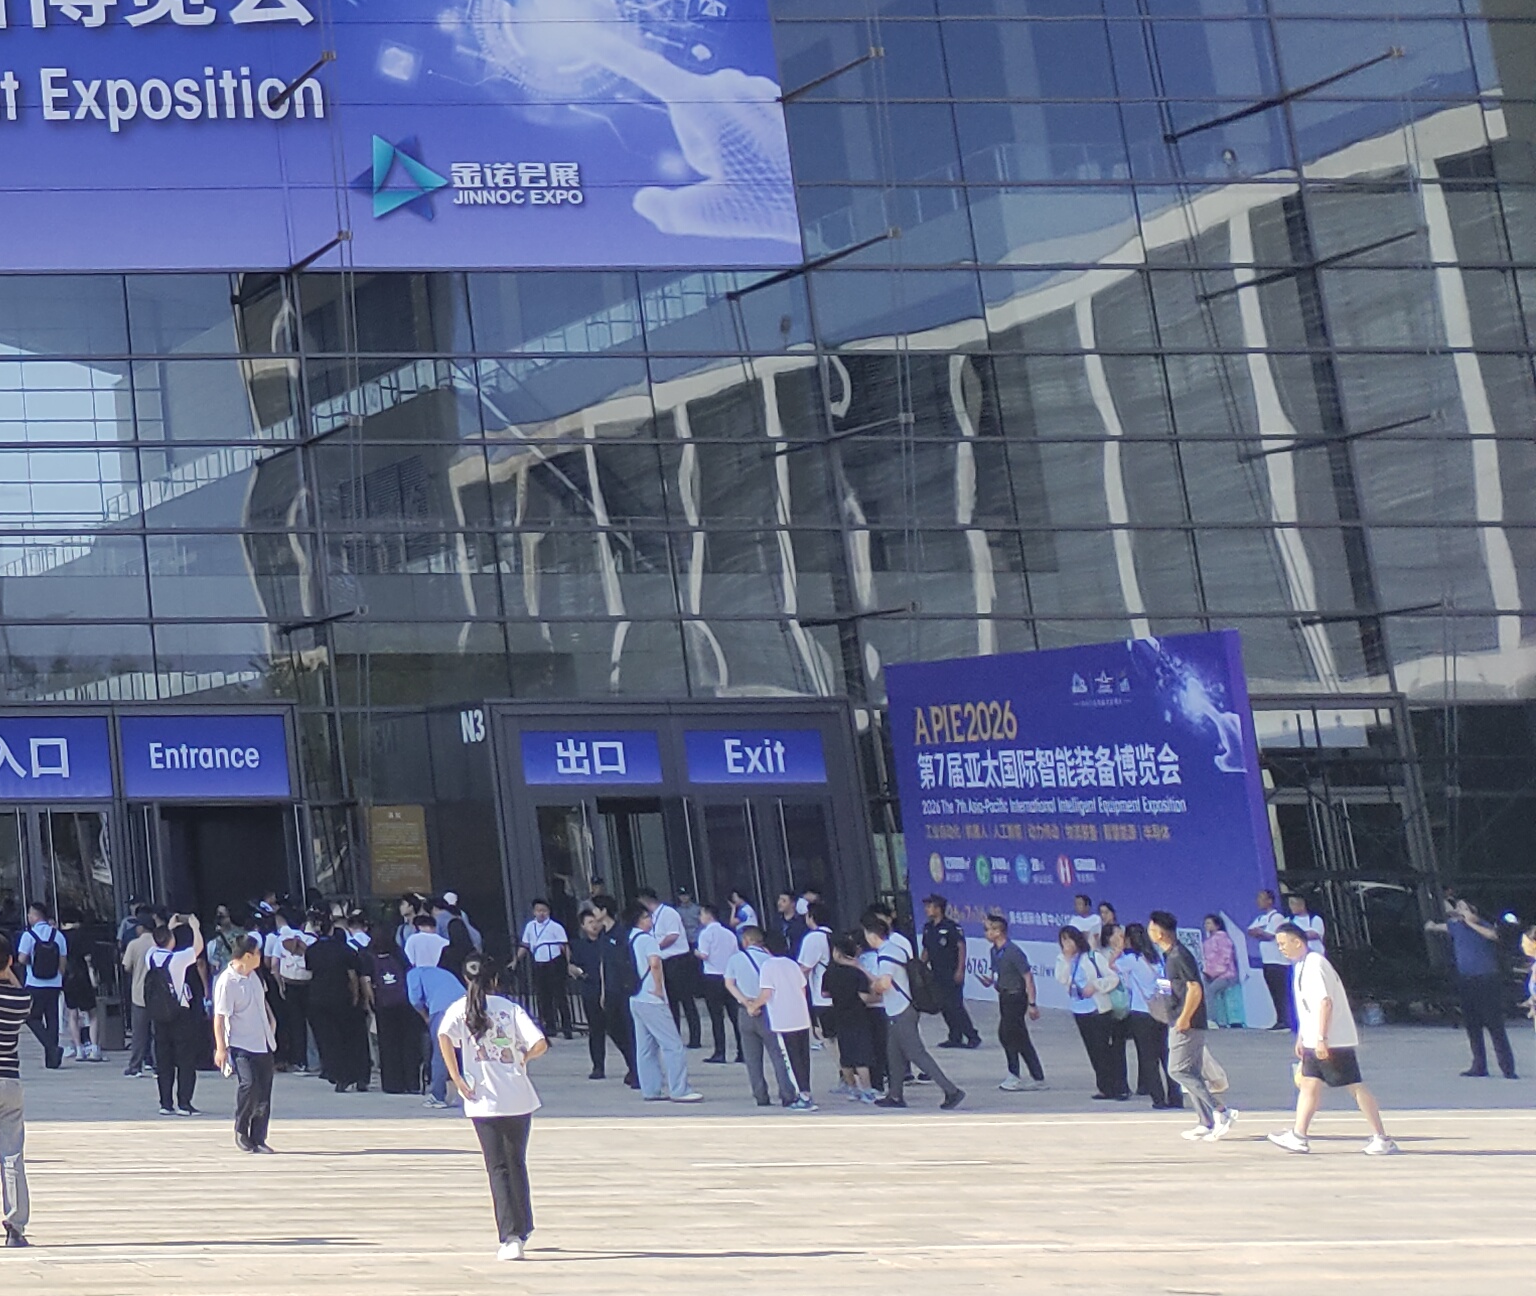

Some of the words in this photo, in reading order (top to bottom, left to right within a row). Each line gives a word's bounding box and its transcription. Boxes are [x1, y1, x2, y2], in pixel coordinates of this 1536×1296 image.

[39, 63, 325, 134] Exposition
[450, 162, 581, 188] 金诺会展
[453, 190, 526, 205] JINNOC
[530, 190, 584, 204] EXPO
[460, 708, 486, 744] N3
[914, 700, 1018, 746] APIE2026
[149, 742, 260, 770] Entrance
[556, 738, 627, 776] 出口
[724, 737, 786, 775] Exit
[917, 742, 1182, 790] 第7届亚太国际智能装备博览会
